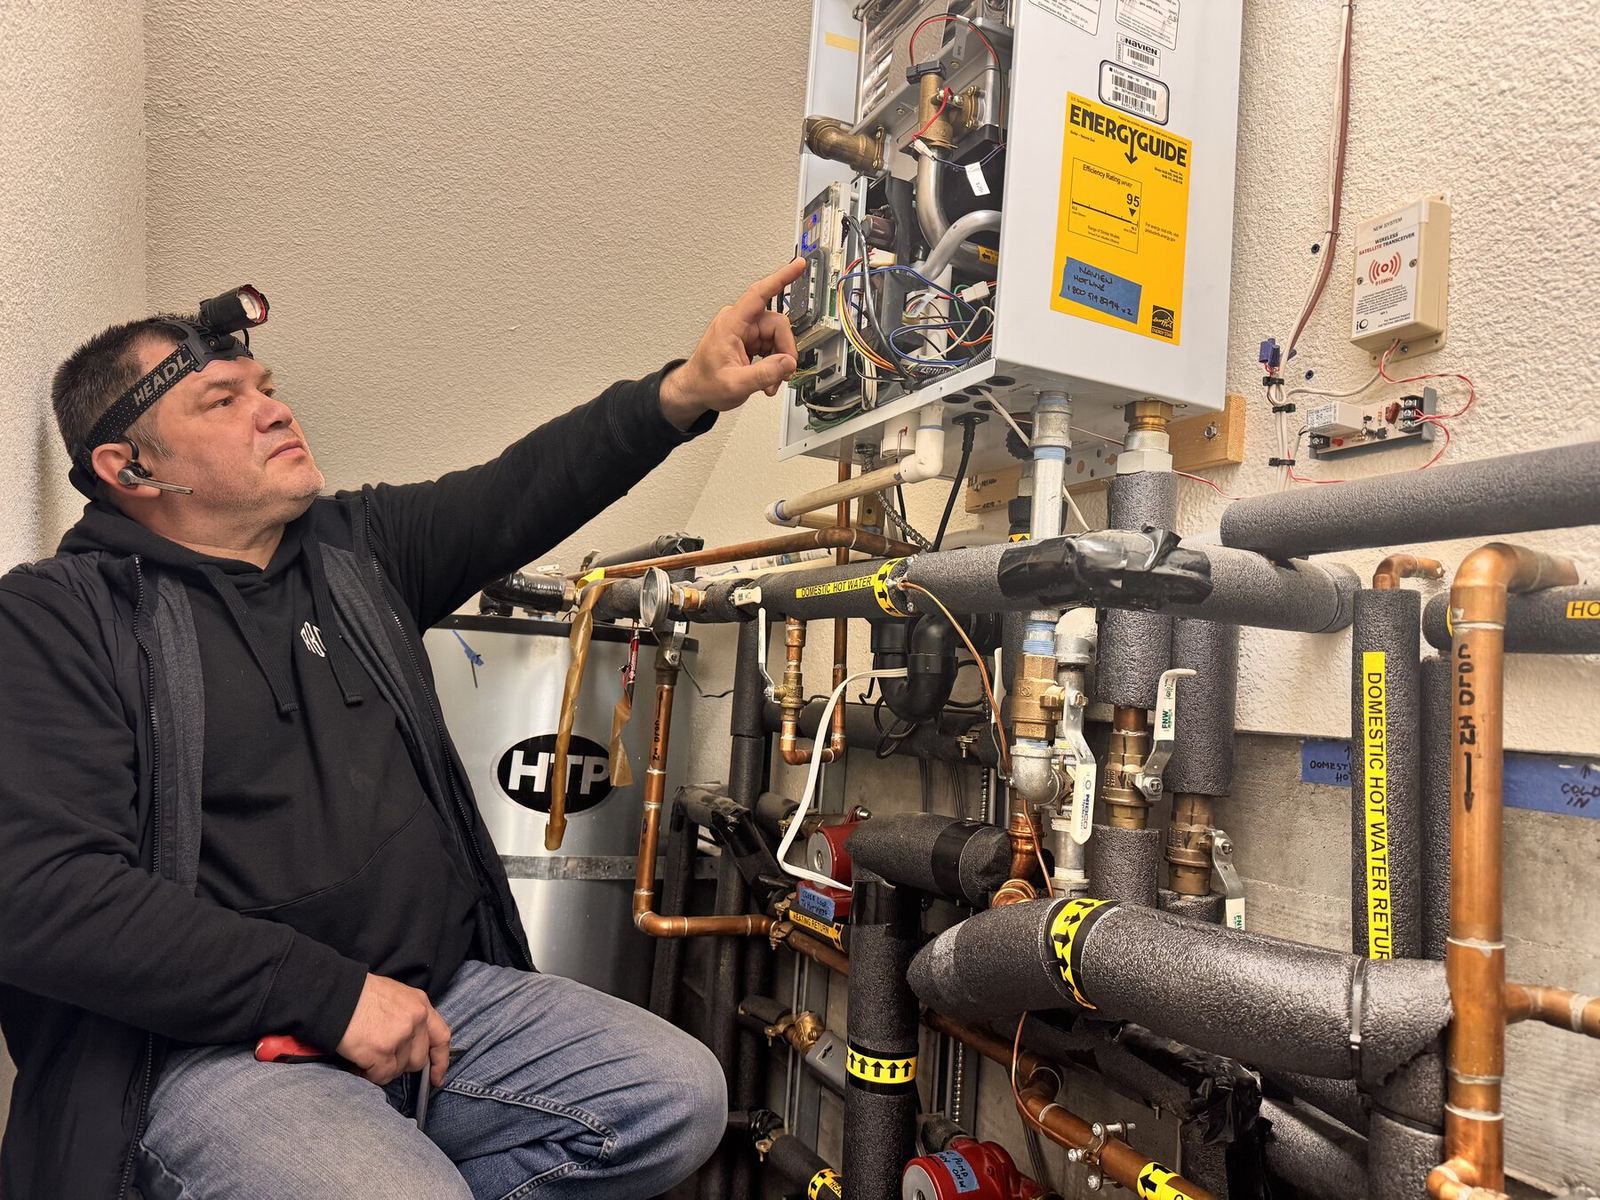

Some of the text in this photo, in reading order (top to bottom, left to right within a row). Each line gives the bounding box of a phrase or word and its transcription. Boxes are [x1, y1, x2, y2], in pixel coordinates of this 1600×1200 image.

[1070, 104, 1188, 168] ENERGYGUIDE
[1082, 164, 1106, 180] Efficiency
[1106, 172, 1120, 185] Rating
[1126, 193, 1140, 208] 95
[1373, 224, 1383, 232] NEW
[1374, 232, 1399, 244] WIRELESS
[1358, 232, 1415, 256] SATELLITE TRANSCEIVER
[1072, 286, 1086, 296] 800
[802, 576, 872, 598] DOMESTIC HOT WATER
[1458, 643, 1476, 706] COLD
[1367, 671, 1385, 770] DOMESTIC
[508, 750, 610, 795] HTP
[1369, 777, 1386, 816] HOT
[1561, 782, 1600, 798] COLD
[1566, 796, 1590, 808] IN
[1370, 821, 1388, 891] WATER
